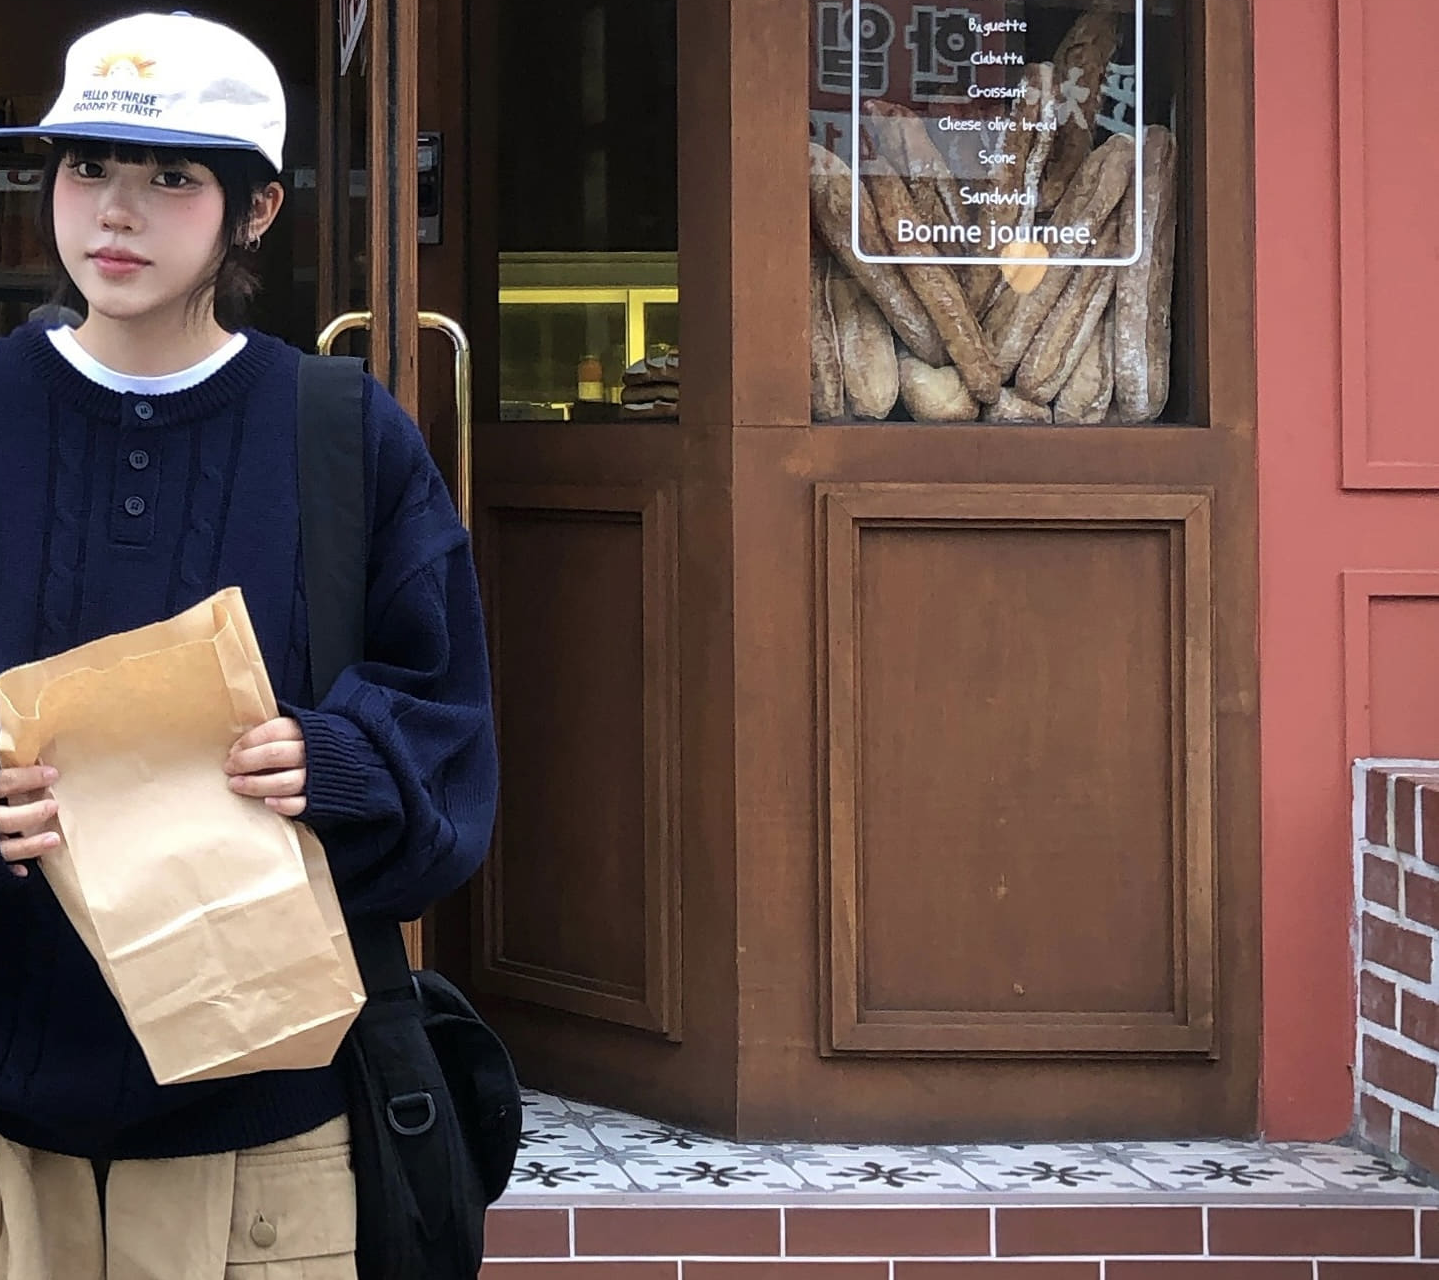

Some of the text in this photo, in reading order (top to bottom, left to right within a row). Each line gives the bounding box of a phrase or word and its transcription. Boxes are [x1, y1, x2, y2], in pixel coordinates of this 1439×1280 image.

[968, 17, 1028, 37] Baguette
[969, 51, 1025, 66] Ciabatta
[82, 89, 158, 106] HELLO SUNRISE
[967, 84, 1028, 99] Croissant
[73, 101, 163, 118] GOODBYE SUNSET
[938, 115, 1058, 132] Cheese olive bread
[977, 149, 1017, 165] Scone
[959, 186, 1037, 206] Sandwich
[896, 219, 1098, 250] Bonne journee.
